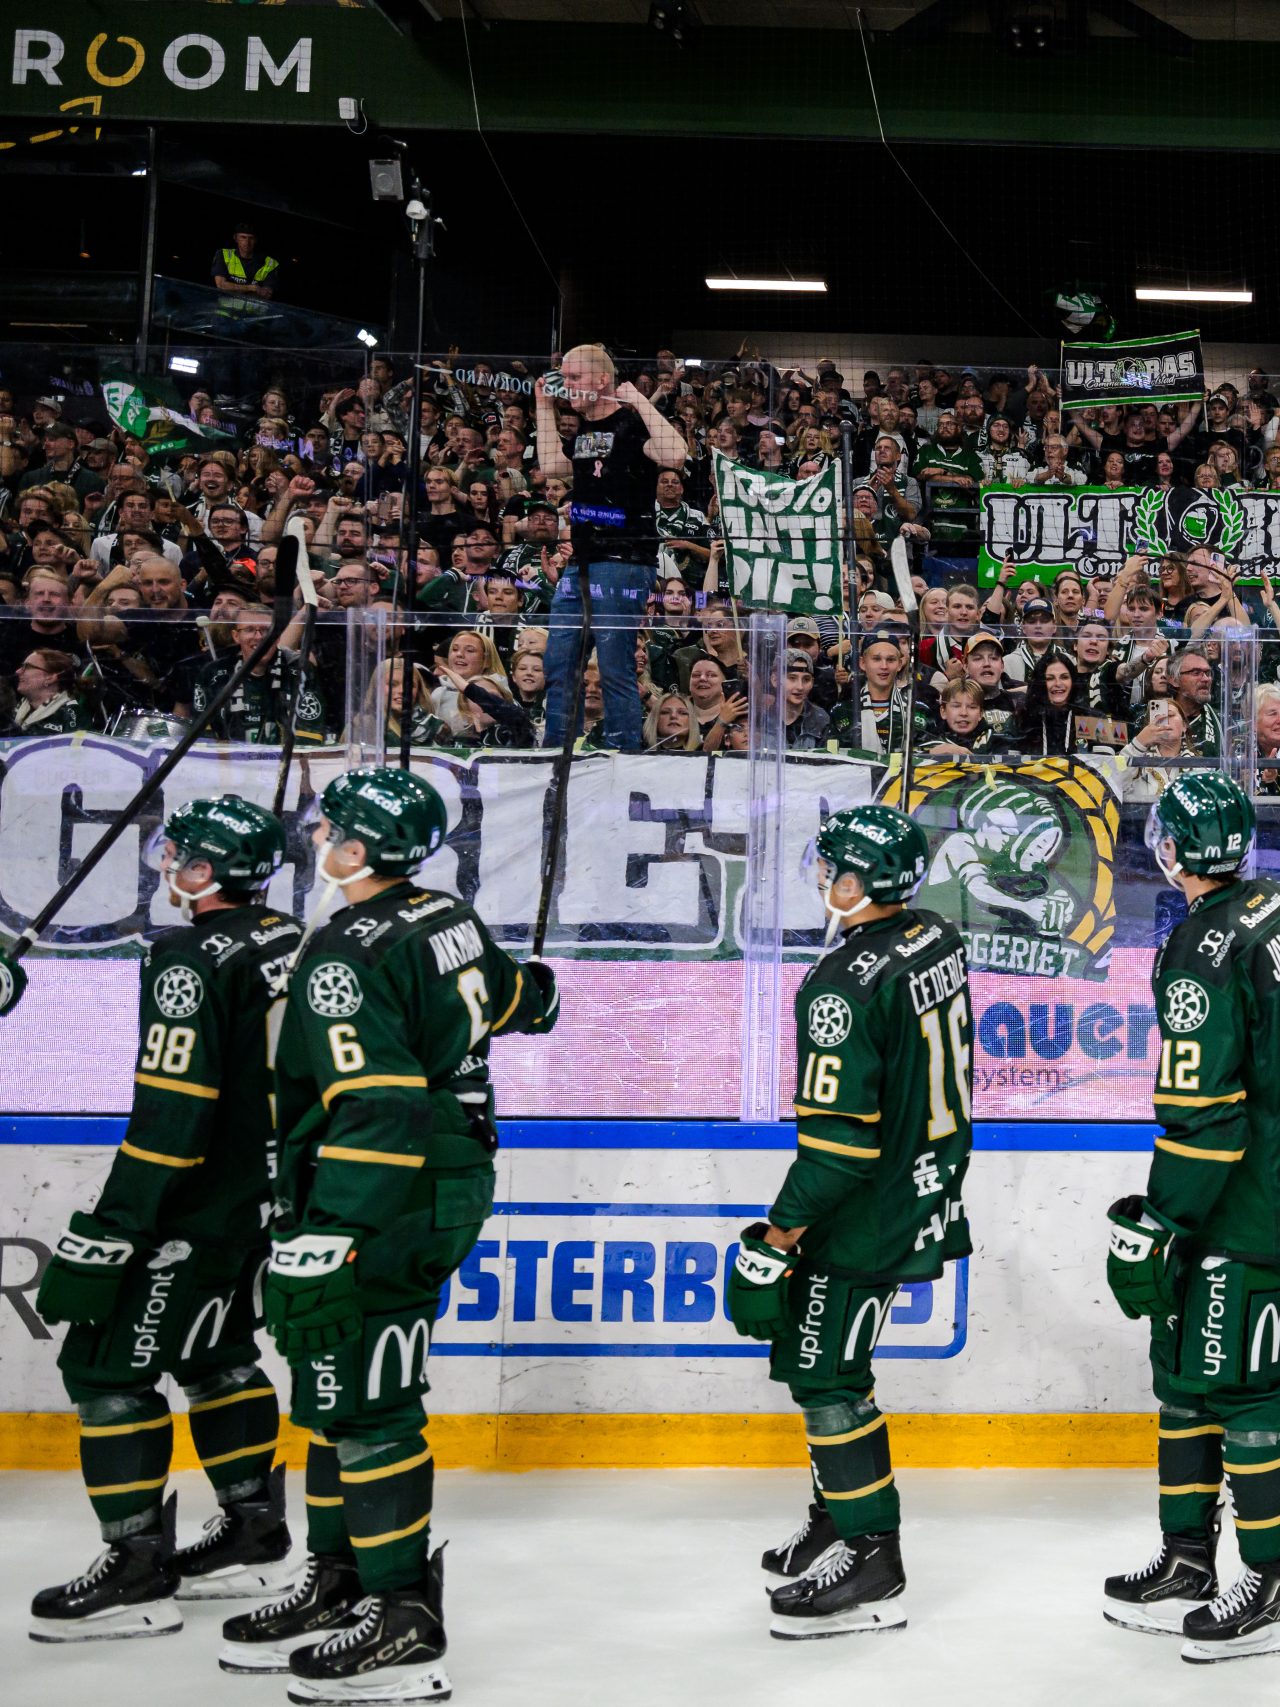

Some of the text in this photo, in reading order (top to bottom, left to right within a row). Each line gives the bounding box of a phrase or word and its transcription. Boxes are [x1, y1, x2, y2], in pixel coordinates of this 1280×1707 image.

[722, 506, 832, 561] ANTI
[732, 554, 834, 611] DIF!
[207, 806, 251, 835] Lecab
[357, 781, 404, 817] Lecab
[848, 817, 893, 845] Lecab
[1226, 832, 1242, 851] 12
[140, 1022, 197, 1075] 98
[327, 1022, 366, 1074] 6
[1159, 1039, 1202, 1091] 12
[801, 1051, 843, 1105] 16
[130, 1270, 177, 1369] upfront
[798, 1274, 830, 1370] upfront
[1200, 1272, 1228, 1377] upfront
[304, 1599, 348, 1630] CCM
[357, 1627, 418, 1675] CCM
